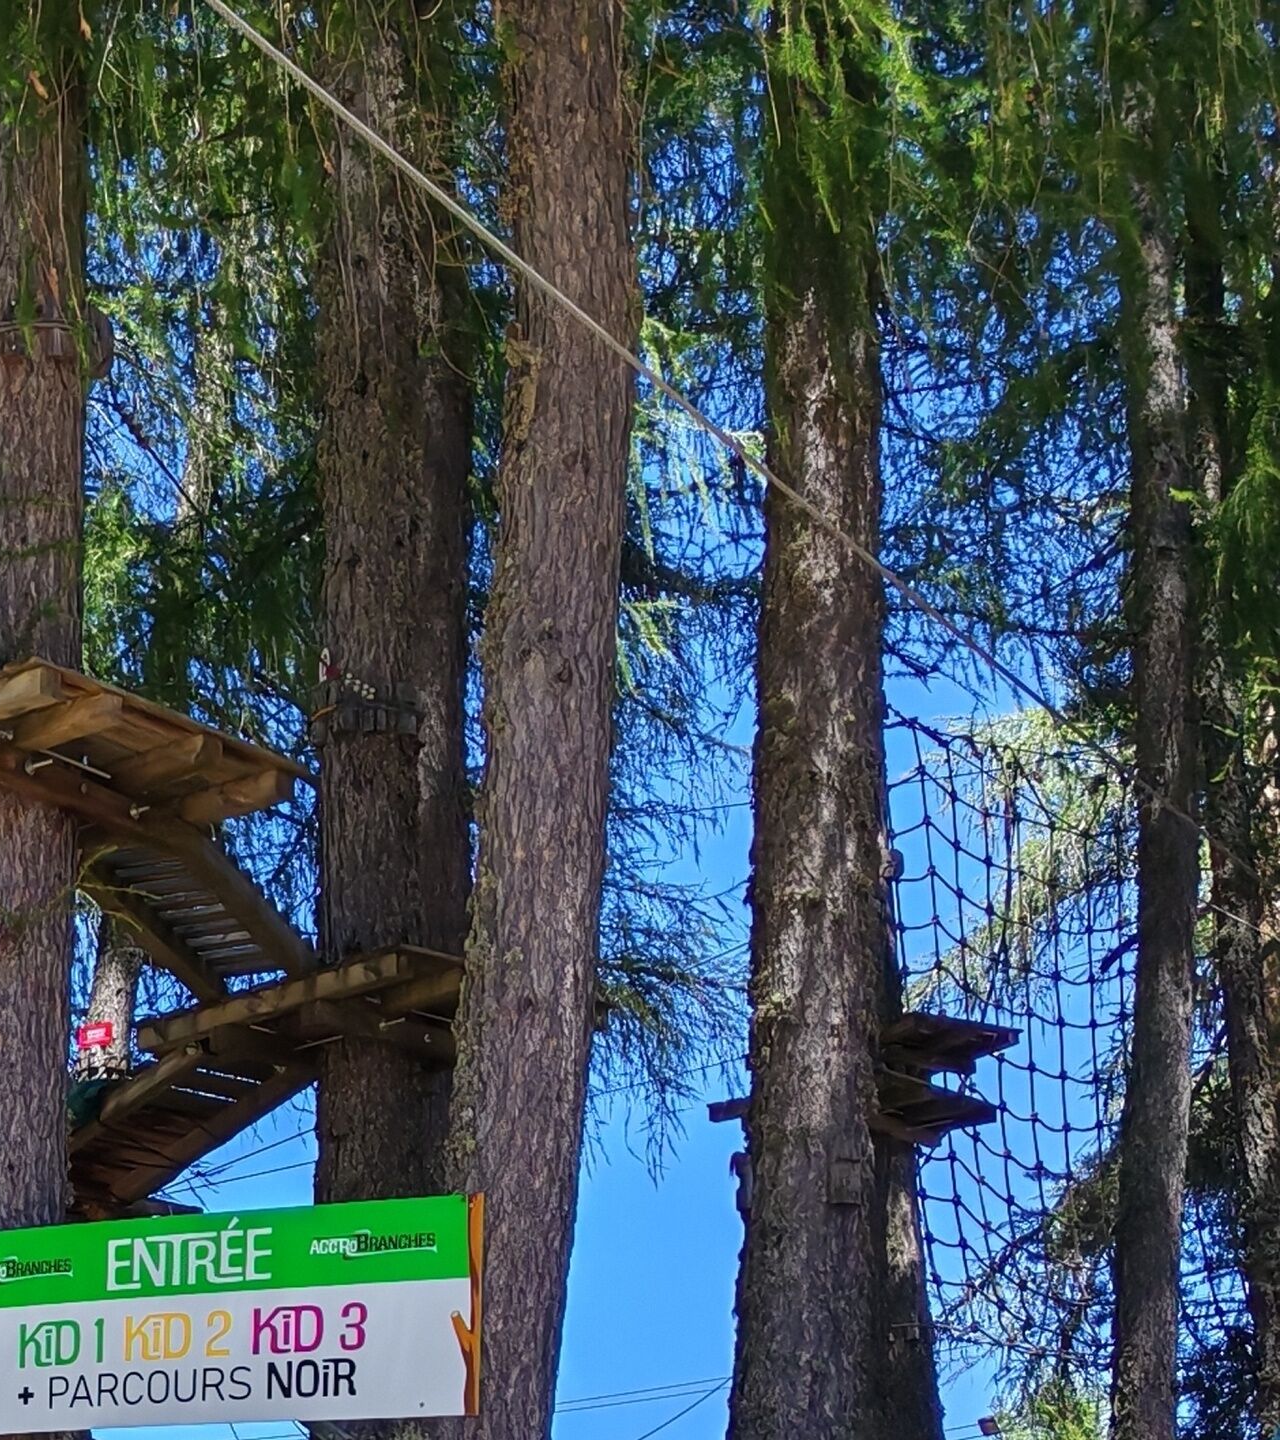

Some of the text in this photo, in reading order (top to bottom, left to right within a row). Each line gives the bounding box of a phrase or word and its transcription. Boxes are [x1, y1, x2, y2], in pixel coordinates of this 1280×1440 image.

[106, 1216, 273, 1291] ENTRÉE
[94, 1318, 105, 1363] 1
[206, 1310, 232, 1357] 2
[340, 1302, 368, 1351] 3
[48, 1366, 252, 1409] PARCOURS
